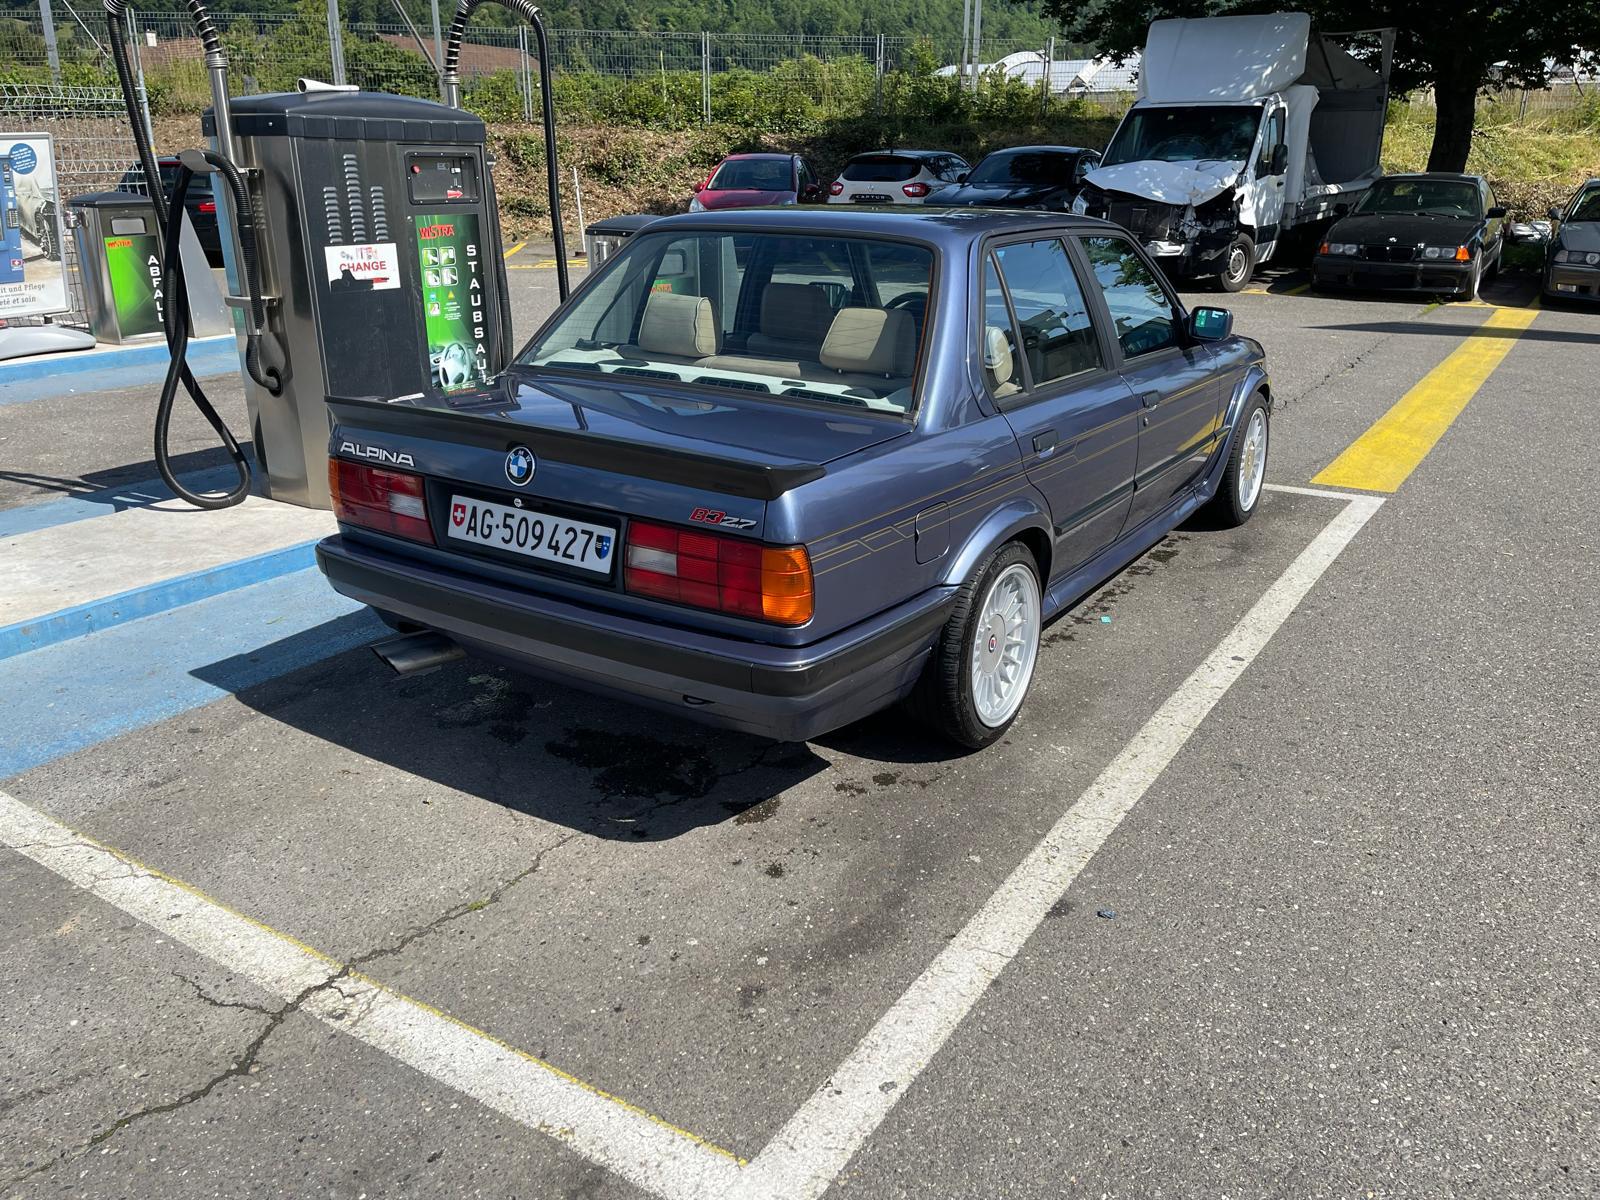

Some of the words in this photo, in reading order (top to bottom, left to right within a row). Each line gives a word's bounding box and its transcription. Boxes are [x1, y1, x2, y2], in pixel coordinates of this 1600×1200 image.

[418, 223, 455, 240] WISTRA
[339, 260, 387, 272] CHANGE
[148, 255, 164, 322] ABFALL
[339, 440, 416, 467] ALPINA
